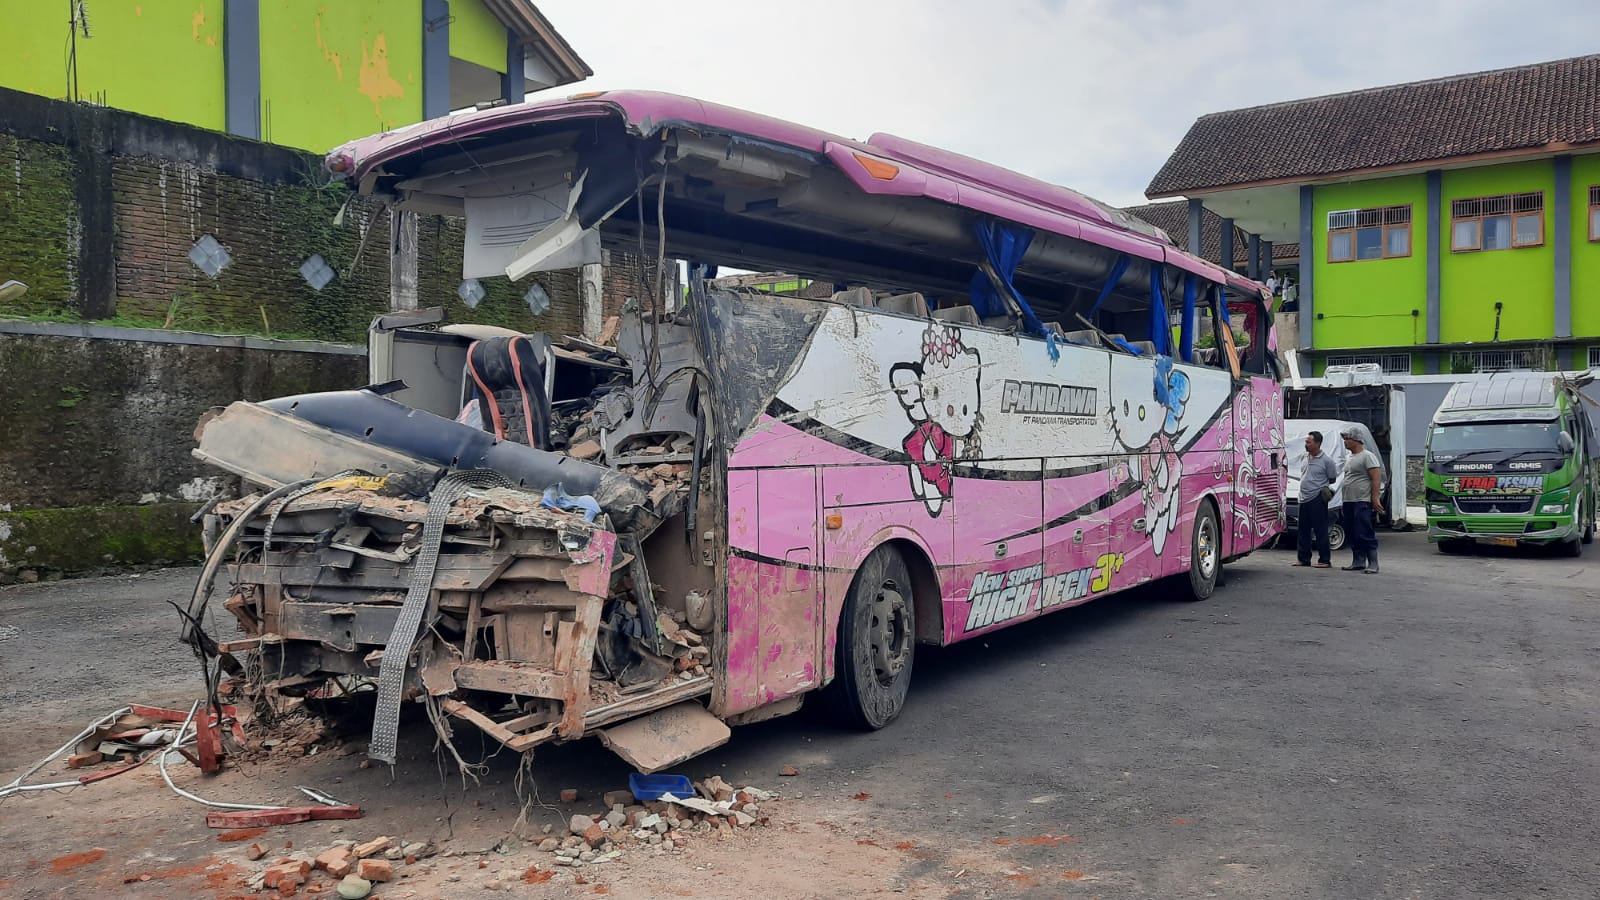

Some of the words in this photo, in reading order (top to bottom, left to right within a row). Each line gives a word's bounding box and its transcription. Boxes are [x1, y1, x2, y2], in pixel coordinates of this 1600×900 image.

[1001, 379, 1097, 417] PANDAWA
[1497, 476, 1544, 489] PESONA
[963, 581, 1034, 633] HIGH
[1034, 567, 1093, 612] DECK
[967, 570, 1007, 603] NEW
